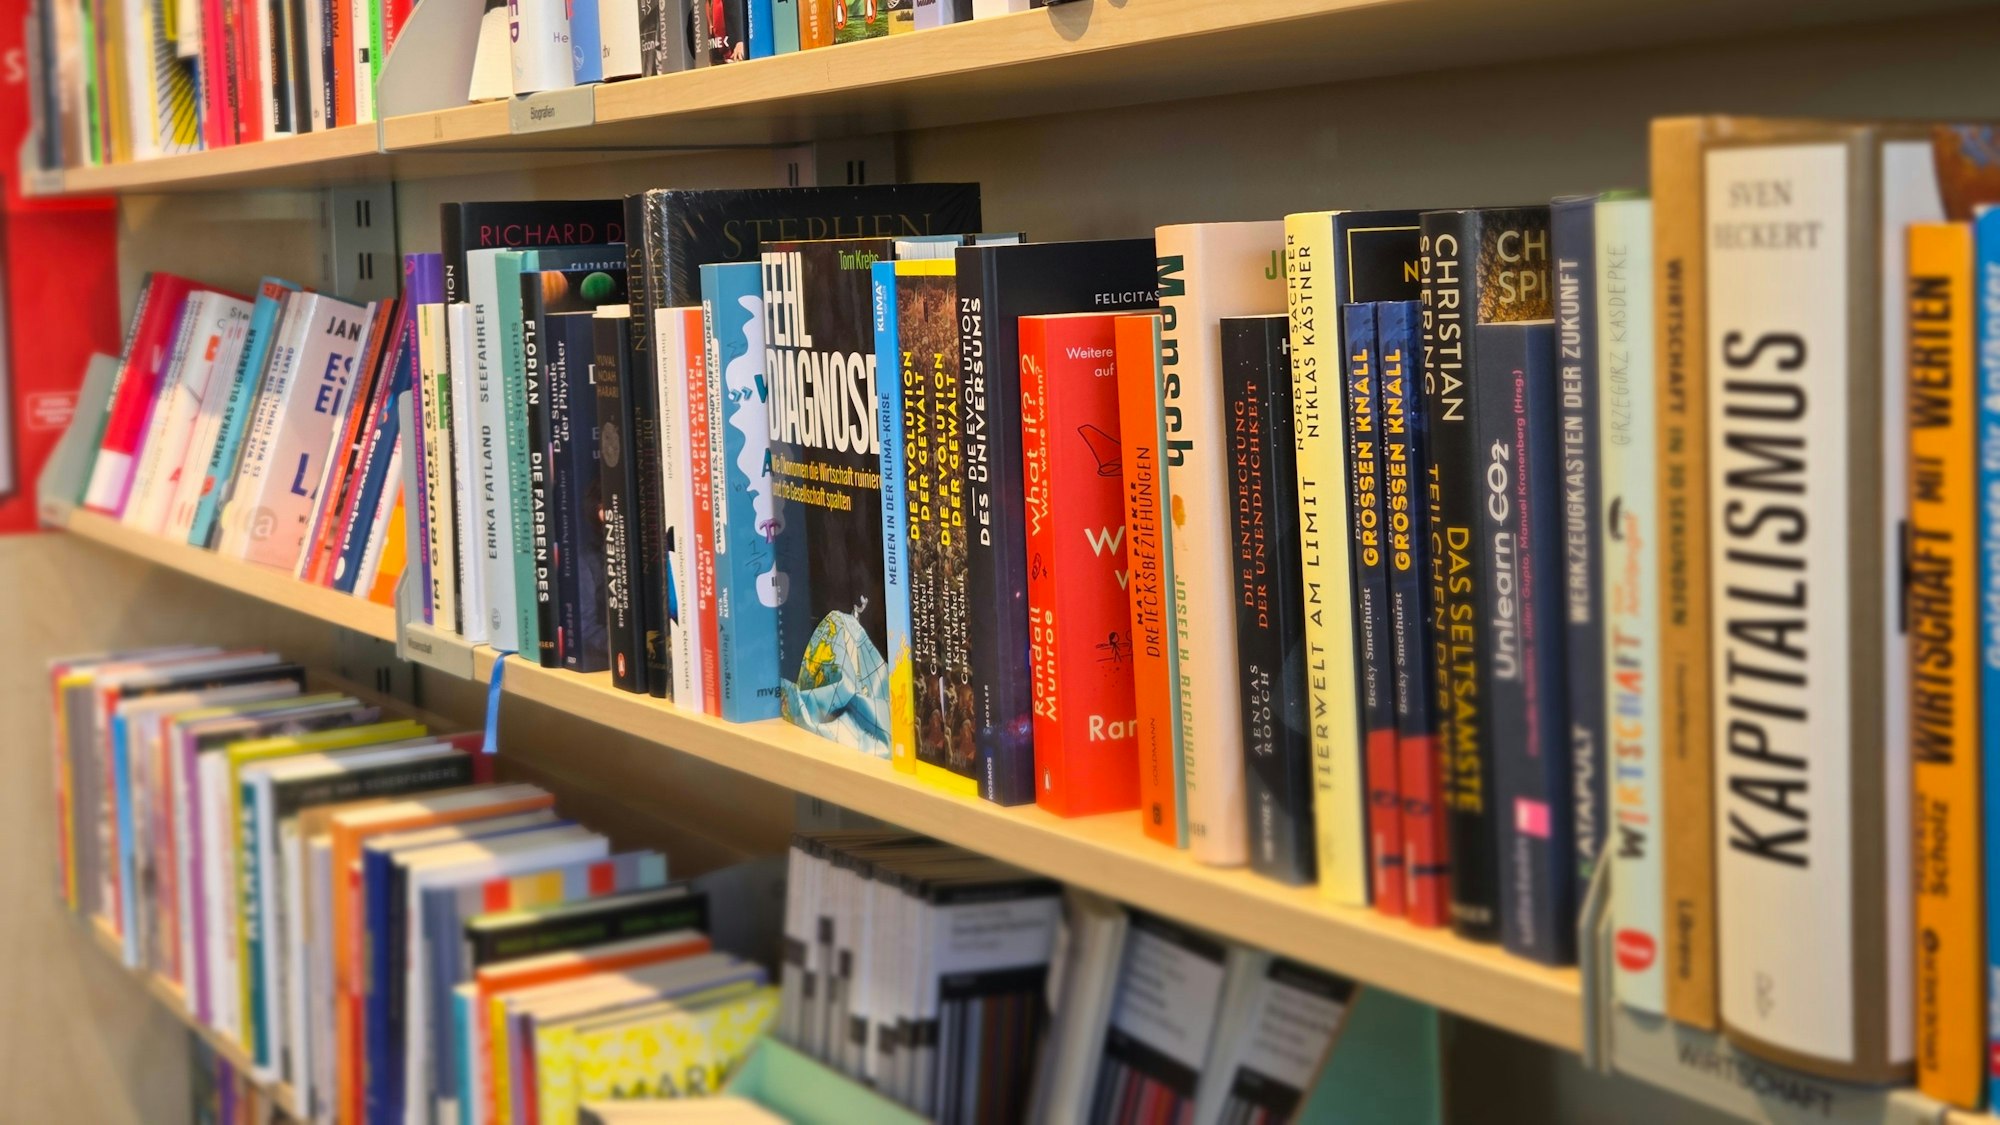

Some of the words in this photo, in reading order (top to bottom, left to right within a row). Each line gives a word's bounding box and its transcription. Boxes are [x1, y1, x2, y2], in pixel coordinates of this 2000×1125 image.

[659, 11, 668, 60] KNAUR
[530, 107, 555, 120] Biografien
[1727, 182, 1793, 208] SVEN
[480, 224, 594, 246] RICHARD
[723, 214, 931, 259] STEPHEN
[838, 250, 854, 271] Tom
[855, 250, 880, 271] Krebs
[630, 249, 647, 350] STEPHEN
[761, 252, 812, 347] FEHL
[1094, 290, 1162, 305] FELICITAS
[1287, 234, 1299, 334] SACHSER
[1298, 246, 1316, 345] KÄSTNER
[1419, 235, 1436, 395] SPIERING
[1559, 258, 1582, 360] ZUKUNFT
[1607, 244, 1630, 346] KASDEPKE
[326, 316, 362, 341] JAN
[475, 303, 489, 403] SEEFAHRER
[1066, 346, 1114, 360] Weitere
[1156, 254, 1194, 467] Mensch
[1434, 233, 1465, 421] CHRISTIAN
[1664, 258, 1688, 415] WIRTSCHAFT
[1910, 275, 1953, 429] WERTEN
[511, 321, 526, 422] Staunens
[523, 320, 539, 405] FLORIAN
[549, 362, 560, 420] Stunde
[558, 340, 569, 409] Physiker
[694, 354, 704, 422] RETTEN
[961, 297, 976, 436] EVOLUTION
[971, 297, 989, 484] UNIVERSUMS
[1022, 353, 1035, 374] 2
[1035, 366, 1045, 422] wenn?
[1094, 365, 1114, 377] auf
[1352, 349, 1373, 432] KNALL
[1384, 349, 1406, 434] KNALL
[1511, 369, 1525, 414] (Hrsg.)
[1563, 366, 1583, 409] DER
[212, 406, 235, 468] AMERIKAS
[229, 329, 257, 402] OLIGARCHEN
[256, 439, 268, 461] WAR
[262, 396, 281, 435] EINMAL
[274, 375, 286, 393] EIN
[280, 346, 295, 373] LAND
[423, 368, 432, 430] GUT
[560, 414, 569, 441] der
[689, 368, 699, 460] PFLANZEN
[765, 349, 881, 455] DIAGNOSE
[902, 351, 918, 491] EVOLUTION
[915, 371, 928, 466] GEWALT
[933, 353, 949, 497] EVOLUTION
[946, 374, 960, 470] GEWALT
[1022, 391, 1037, 434] if?
[1290, 346, 1304, 450] NORBERT
[1301, 357, 1320, 437] NIKLAS
[1609, 351, 1631, 447] GRZEGORZ
[481, 425, 495, 501] FATLAND
[531, 452, 543, 482] DIE
[552, 424, 561, 453] Die
[698, 430, 707, 476] WELT
[780, 453, 809, 479] Ökonomen
[809, 460, 819, 480] die
[819, 462, 854, 486] Wirtschaft
[881, 393, 893, 481] KLIMA-KRISE
[967, 443, 978, 481] DIE
[1038, 428, 1048, 472] wäre
[1514, 418, 1528, 496] Kronenberg
[427, 441, 439, 566] GRUNDE
[693, 466, 701, 496] MIT
[701, 482, 709, 512] DIE
[790, 481, 826, 507] Gesellschaft
[826, 488, 852, 512] spalten
[884, 484, 895, 511] DER
[919, 475, 930, 521] DER
[949, 479, 962, 527] DER
[1040, 481, 1049, 517] Was
[1234, 399, 1254, 560] ENTDECKUNG
[1246, 380, 1267, 575] UNENDLICHKEIT
[1357, 441, 1380, 567] GROSSEN
[1389, 443, 1411, 571] GROSSEN
[1915, 454, 1945, 505] MIT
[487, 508, 498, 560] ERIKA
[533, 488, 547, 561] FARBEN
[612, 494, 621, 562] GESCHICHTE
[619, 515, 628, 586] MENSCHHEIT
[886, 514, 896, 529] IN
[908, 501, 920, 540] DIE
[940, 505, 951, 546] DIE
[978, 493, 990, 546] DES
[1130, 481, 1140, 557] PARKER
[1136, 446, 1160, 658] DREIECKSBEZIEHUNGEN
[1302, 476, 1320, 567] LIMIT
[1427, 464, 1446, 630] TEILCHEN
[1517, 499, 1530, 549] Manuel
[1564, 416, 1590, 625] WERKZEUGKASTEN
[536, 566, 549, 602] DES
[605, 509, 618, 609] SAPIENS
[696, 533, 706, 610] Bernhard
[886, 532, 898, 585] MEDIEN
[910, 571, 920, 614] Meller
[925, 566, 935, 611] Schaik
[1243, 567, 1256, 607] DIE
[1446, 527, 1472, 594] DAS
[919, 583, 929, 627] Michel
[941, 578, 951, 622] Meller
[949, 590, 959, 635] Michel
[956, 572, 966, 620] Schaik
[1134, 569, 1144, 625] MATT
[1175, 574, 1189, 640] JOSEF
[1256, 584, 1269, 629] DER
[1308, 582, 1322, 627] AM
[1360, 587, 1375, 660] Smethurst
[1391, 592, 1406, 667] Smethurst
[1492, 532, 1518, 679] Unlearn
[1722, 330, 1810, 870] KAPITALISMUS
[703, 647, 715, 697] DUMONT
[912, 617, 922, 663] Harald
[928, 640, 937, 676] Carel
[943, 626, 953, 672] Harald
[960, 648, 969, 686] Carel
[1030, 606, 1045, 716] Randall
[1044, 609, 1058, 722] Munroe
[1911, 527, 1954, 766] WIRTSCHAFT
[1249, 664, 1264, 757] AENEAS
[1365, 664, 1378, 707] Becky
[1395, 670, 1409, 715] Becky
[1435, 642, 1450, 711] DER
[1450, 603, 1484, 812] SELTSAMSTE
[1181, 675, 1197, 792] REICHHOLF
[1260, 672, 1273, 754] ROOCH
[1311, 641, 1332, 792] TIERWELT
[1613, 629, 1649, 859] WIRTSCHAFT
